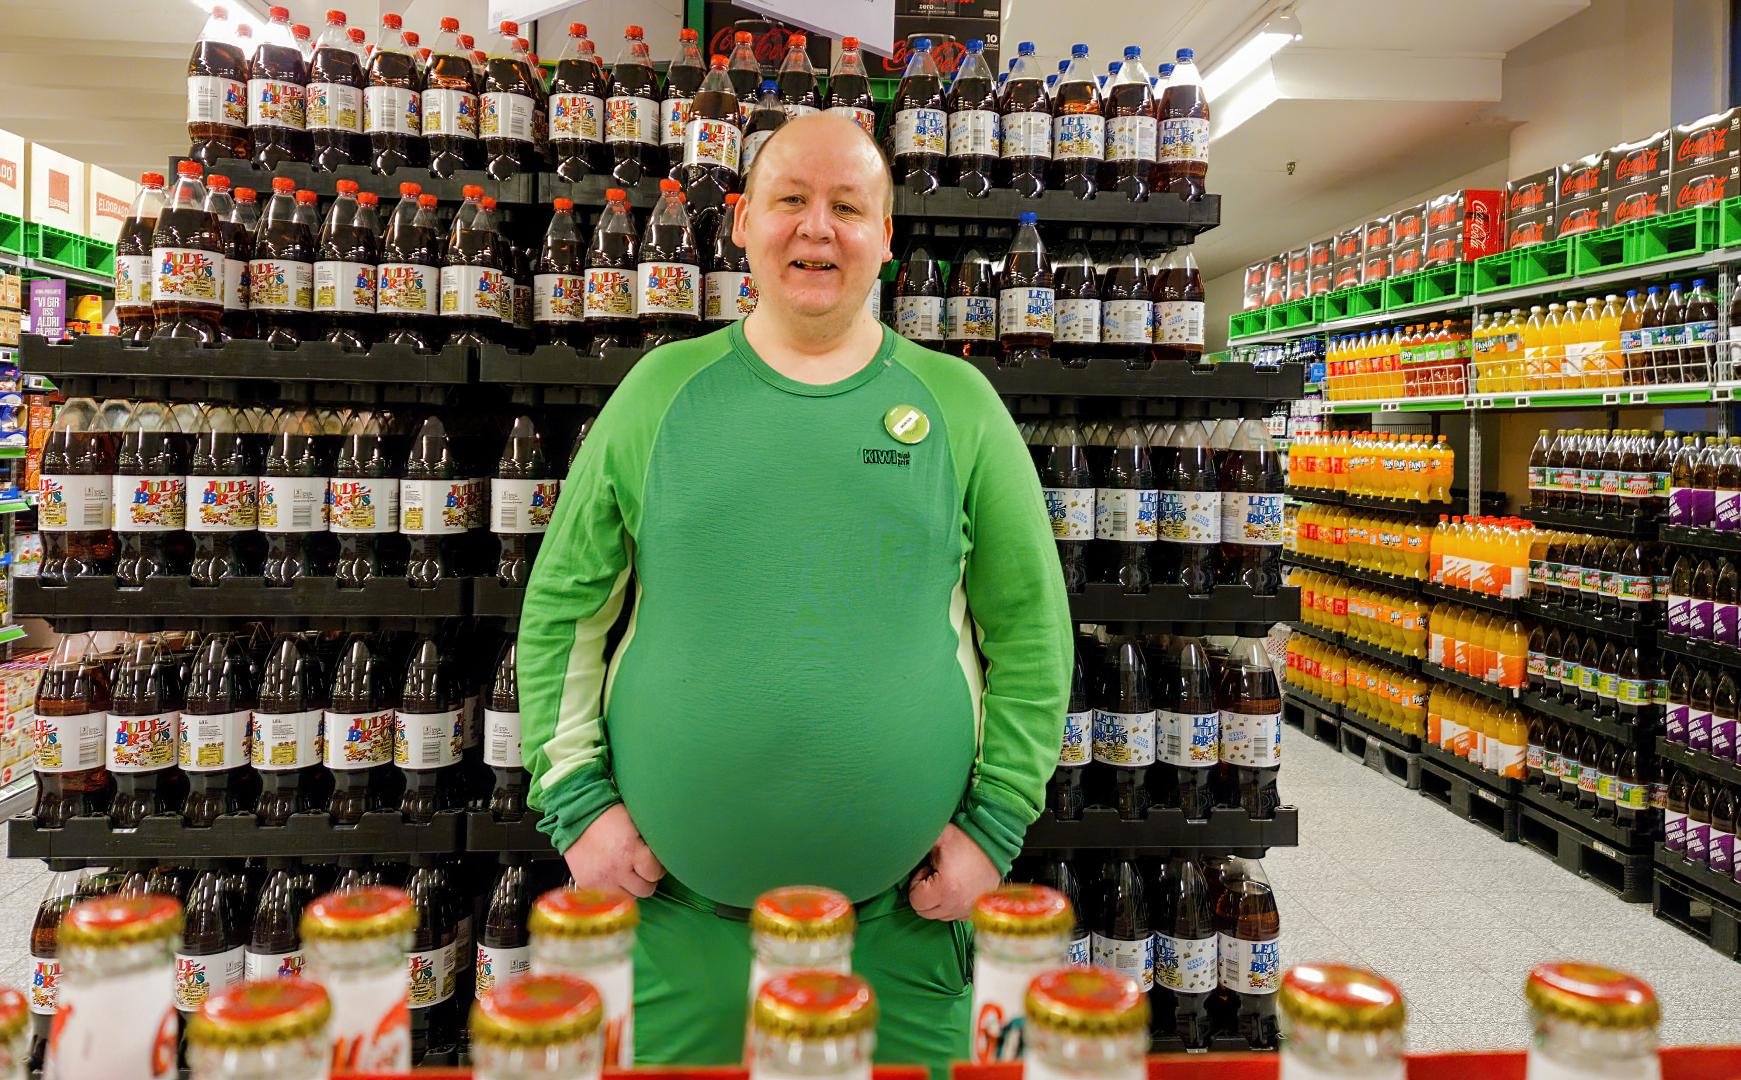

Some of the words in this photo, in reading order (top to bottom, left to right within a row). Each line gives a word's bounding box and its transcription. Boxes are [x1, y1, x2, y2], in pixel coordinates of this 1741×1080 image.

[986, 34, 998, 43] 10
[558, 97, 588, 107] JULE
[163, 251, 203, 264] JULE
[160, 262, 212, 277] BRUS
[382, 267, 414, 278] JULE
[650, 265, 684, 278] JULE
[380, 277, 423, 290] BRUS
[590, 271, 619, 284] JULE
[648, 275, 692, 290] BRUS
[588, 281, 629, 295] BRUS
[48, 297, 59, 307] GIR
[37, 317, 59, 327] ALDRI
[863, 449, 896, 464] KIWI
[138, 480, 179, 492] JULE
[206, 480, 247, 493] JULE
[201, 491, 255, 506] BRUS
[118, 717, 160, 733] JULE
[352, 714, 388, 730] JULE
[115, 728, 170, 746] BRUS
